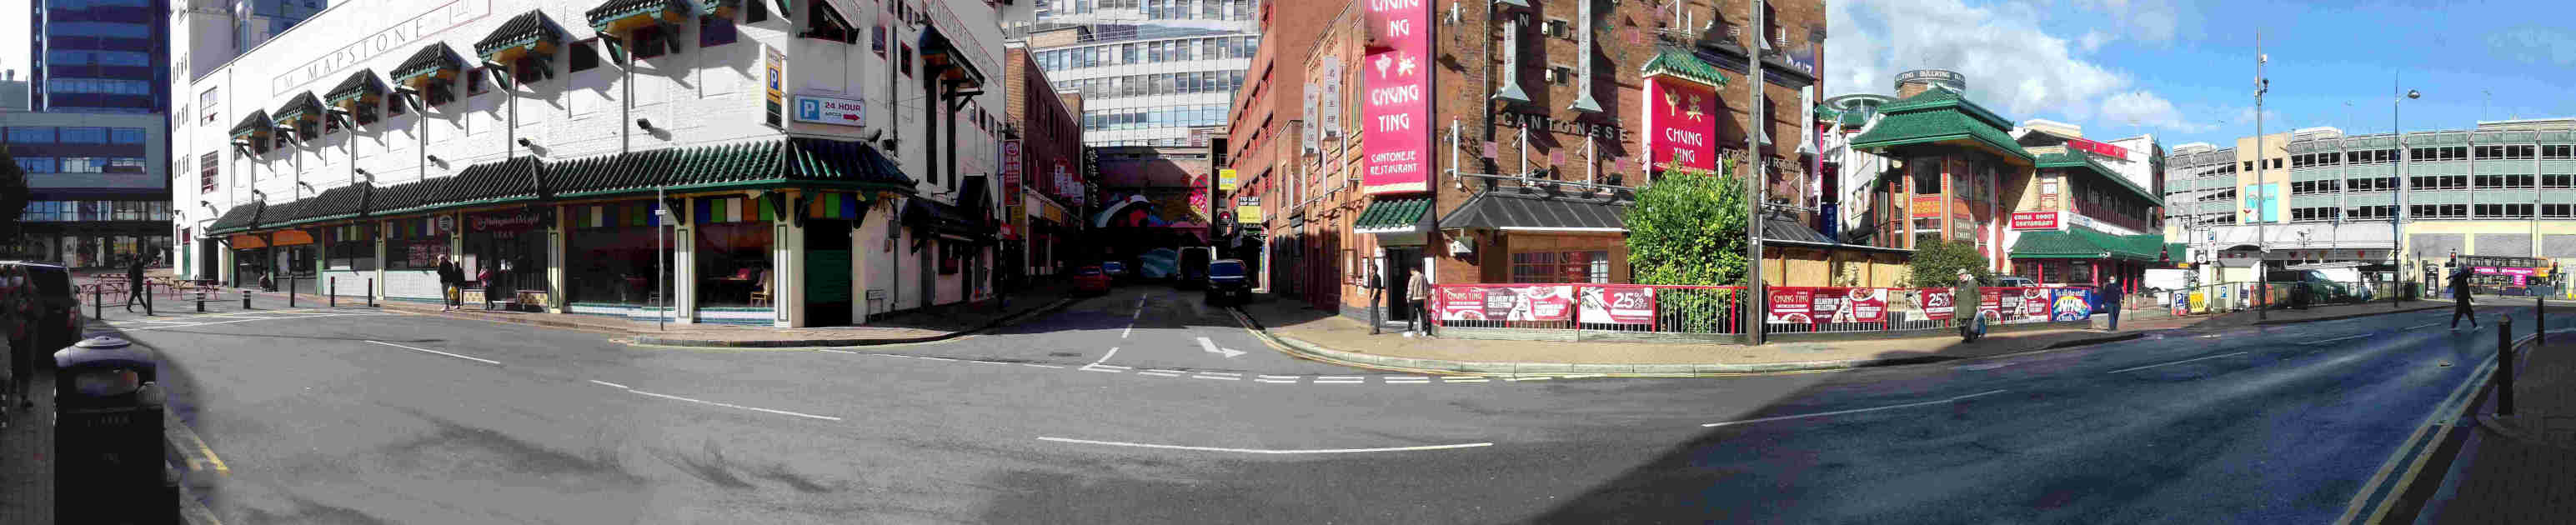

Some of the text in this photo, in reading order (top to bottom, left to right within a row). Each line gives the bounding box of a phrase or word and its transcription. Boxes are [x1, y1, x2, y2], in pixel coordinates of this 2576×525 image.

[308, 18, 423, 81] MAPSTONE
[1371, 84, 1419, 106] CHUNG
[804, 101, 861, 119] P 24 HOUR
[1502, 112, 1628, 144] CANTONESE
[1666, 128, 1702, 147] CHUNG
[1674, 147, 1695, 163] YING
[1370, 162, 1418, 175] RESTAURANT
